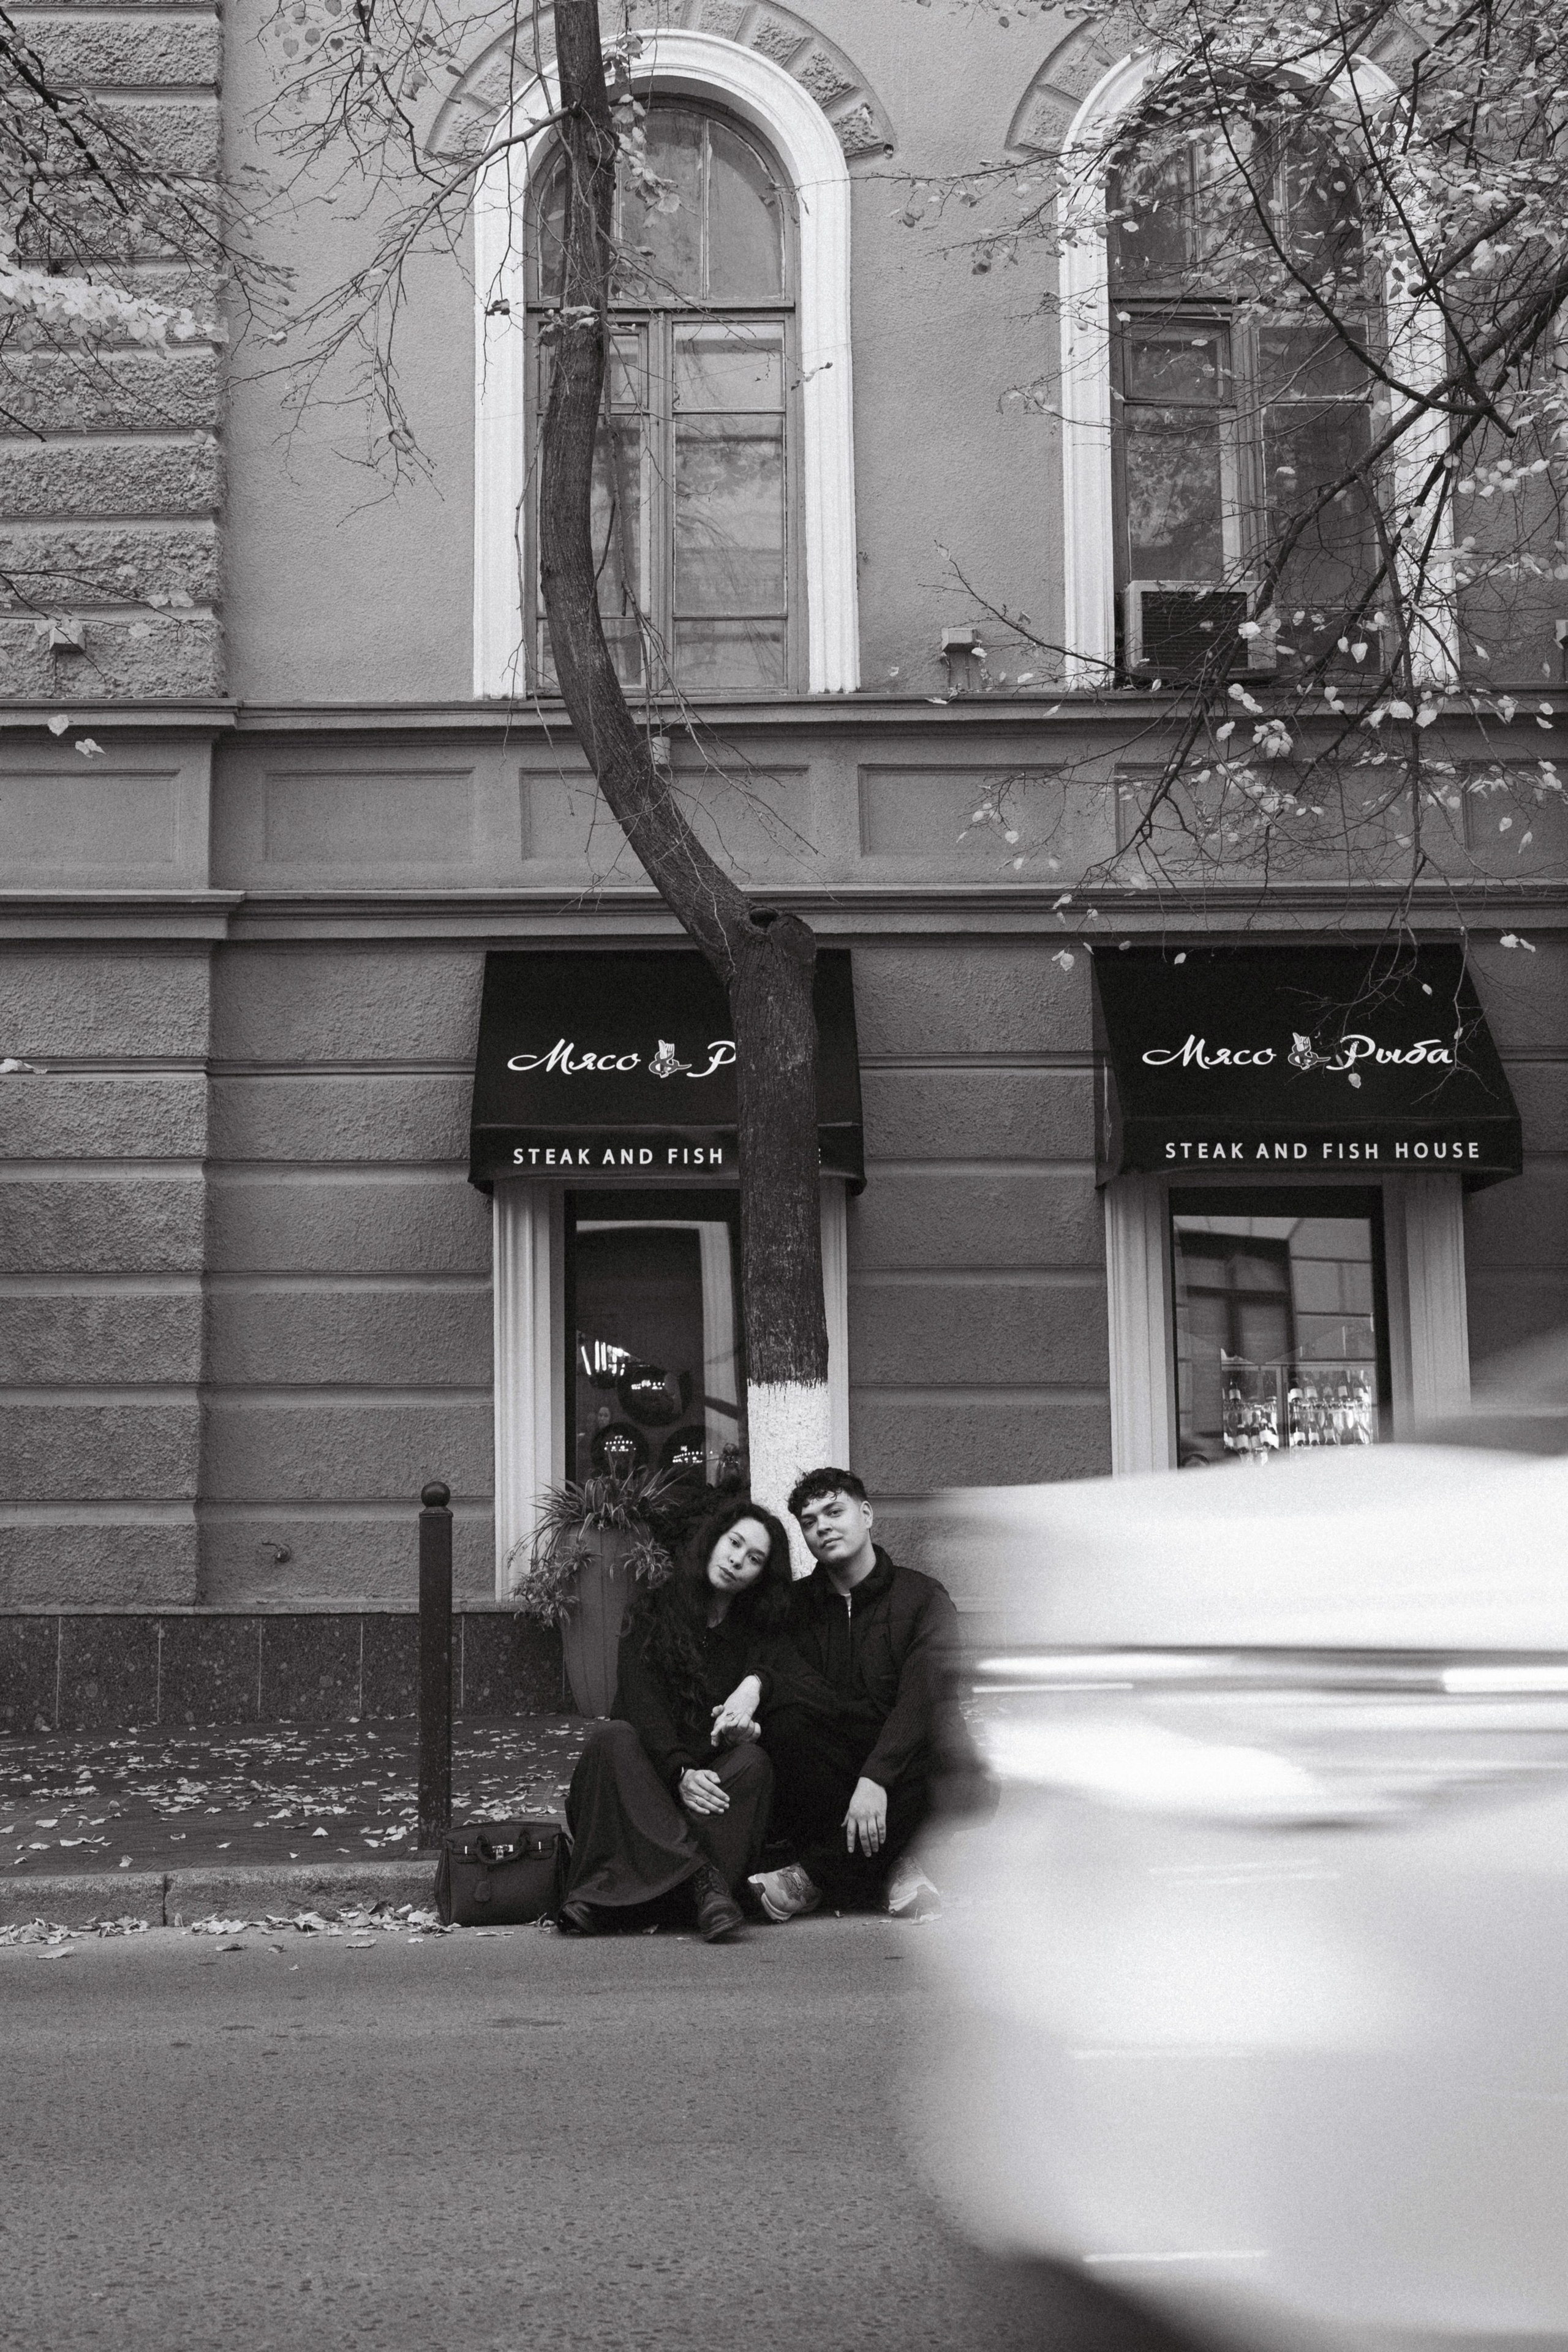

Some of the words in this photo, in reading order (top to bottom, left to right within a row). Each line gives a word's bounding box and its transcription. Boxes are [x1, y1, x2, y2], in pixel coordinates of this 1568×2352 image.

[507, 1038, 641, 1075] Мясо
[1142, 1034, 1277, 1069] Мясо
[1325, 1034, 1453, 1071] Рыба
[513, 1148, 590, 1165] STEAK
[602, 1148, 654, 1165] AND
[668, 1148, 723, 1164] FISH
[1166, 1142, 1243, 1159] STEAK
[1256, 1143, 1308, 1159] AND
[1323, 1142, 1379, 1159] FISH
[1395, 1142, 1480, 1159] HOUSE
